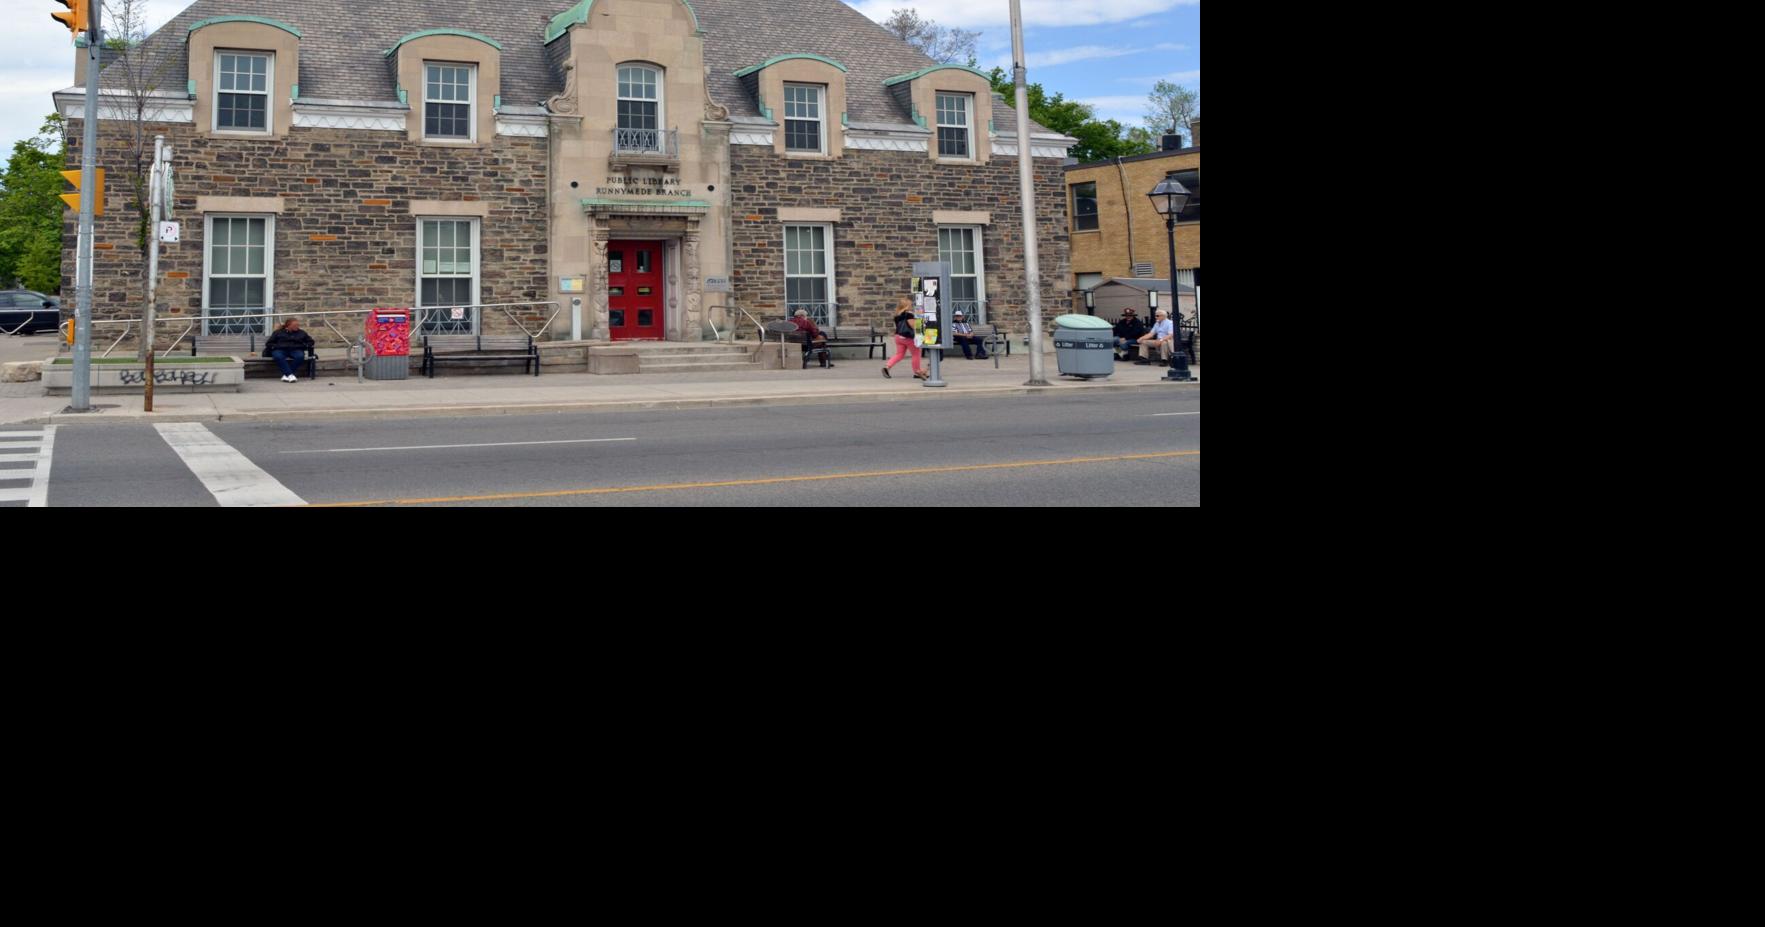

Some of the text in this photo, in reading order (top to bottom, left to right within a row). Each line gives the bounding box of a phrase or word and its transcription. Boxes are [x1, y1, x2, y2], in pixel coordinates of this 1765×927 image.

[606, 176, 681, 185] PUBLIC LIBRARY
[596, 187, 692, 197] RUNNYMEDE BRANCH
